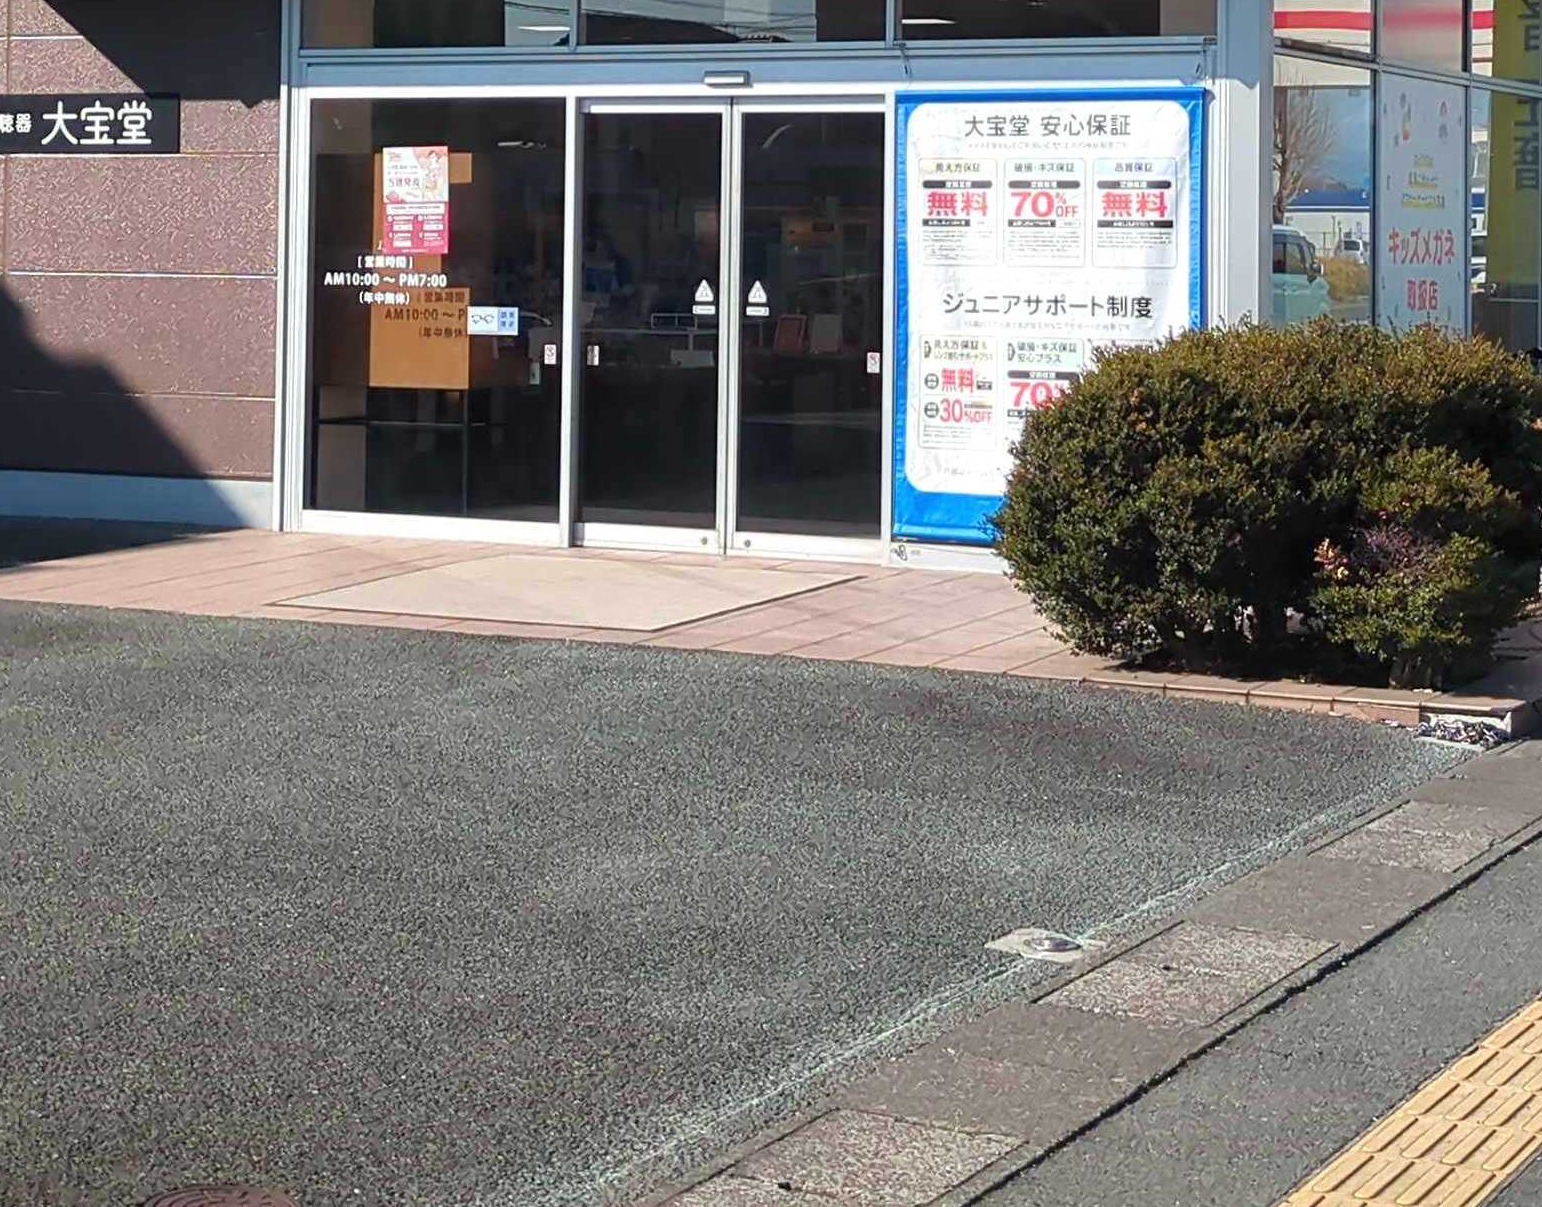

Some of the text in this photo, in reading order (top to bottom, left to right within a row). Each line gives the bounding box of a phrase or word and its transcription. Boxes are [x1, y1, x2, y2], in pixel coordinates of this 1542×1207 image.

[41, 100, 153, 145] 大宝堂
[964, 113, 1132, 138] 大宝堂 安心保証
[927, 191, 988, 217] 無料
[1010, 191, 1055, 218] 70
[1055, 205, 1079, 218] OFF
[1101, 191, 1168, 218] 無料
[324, 272, 380, 286] AM10:00
[399, 273, 448, 287] PM7:00
[942, 292, 1153, 319] ジュニアサポート制度
[941, 367, 974, 394] 無料
[940, 397, 963, 423] 30
